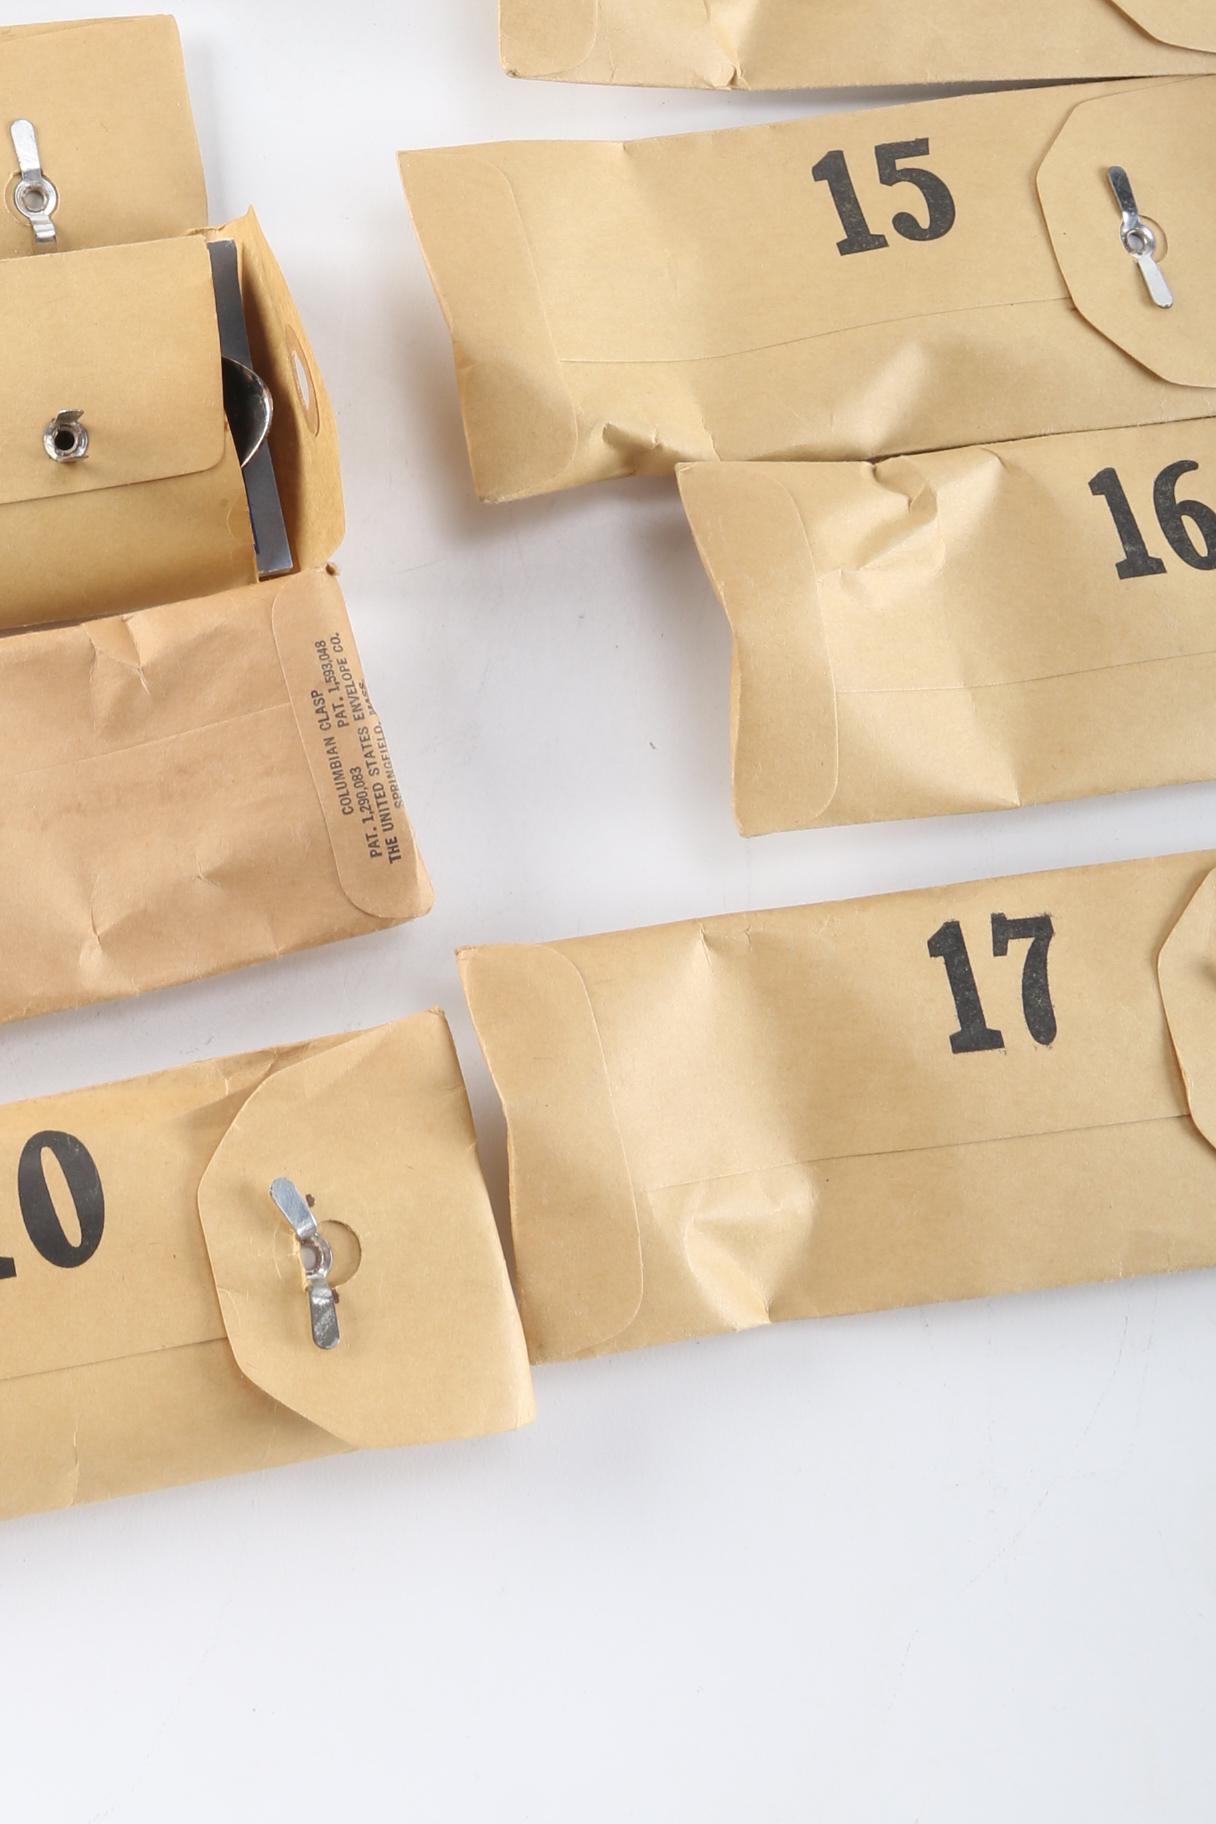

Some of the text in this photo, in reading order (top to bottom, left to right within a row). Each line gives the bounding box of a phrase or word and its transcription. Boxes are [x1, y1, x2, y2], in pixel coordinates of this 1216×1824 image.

[811, 137, 956, 257] 15
[1088, 460, 1216, 580] 16
[310, 689, 354, 816] COLUMBIAN CLASP
[314, 640, 383, 858] PAT. 1,290,083 PAT. 1,593,048
[330, 632, 402, 865] THE UNITED STATES ENVELOPE CO.
[927, 912, 1058, 1056] 17
